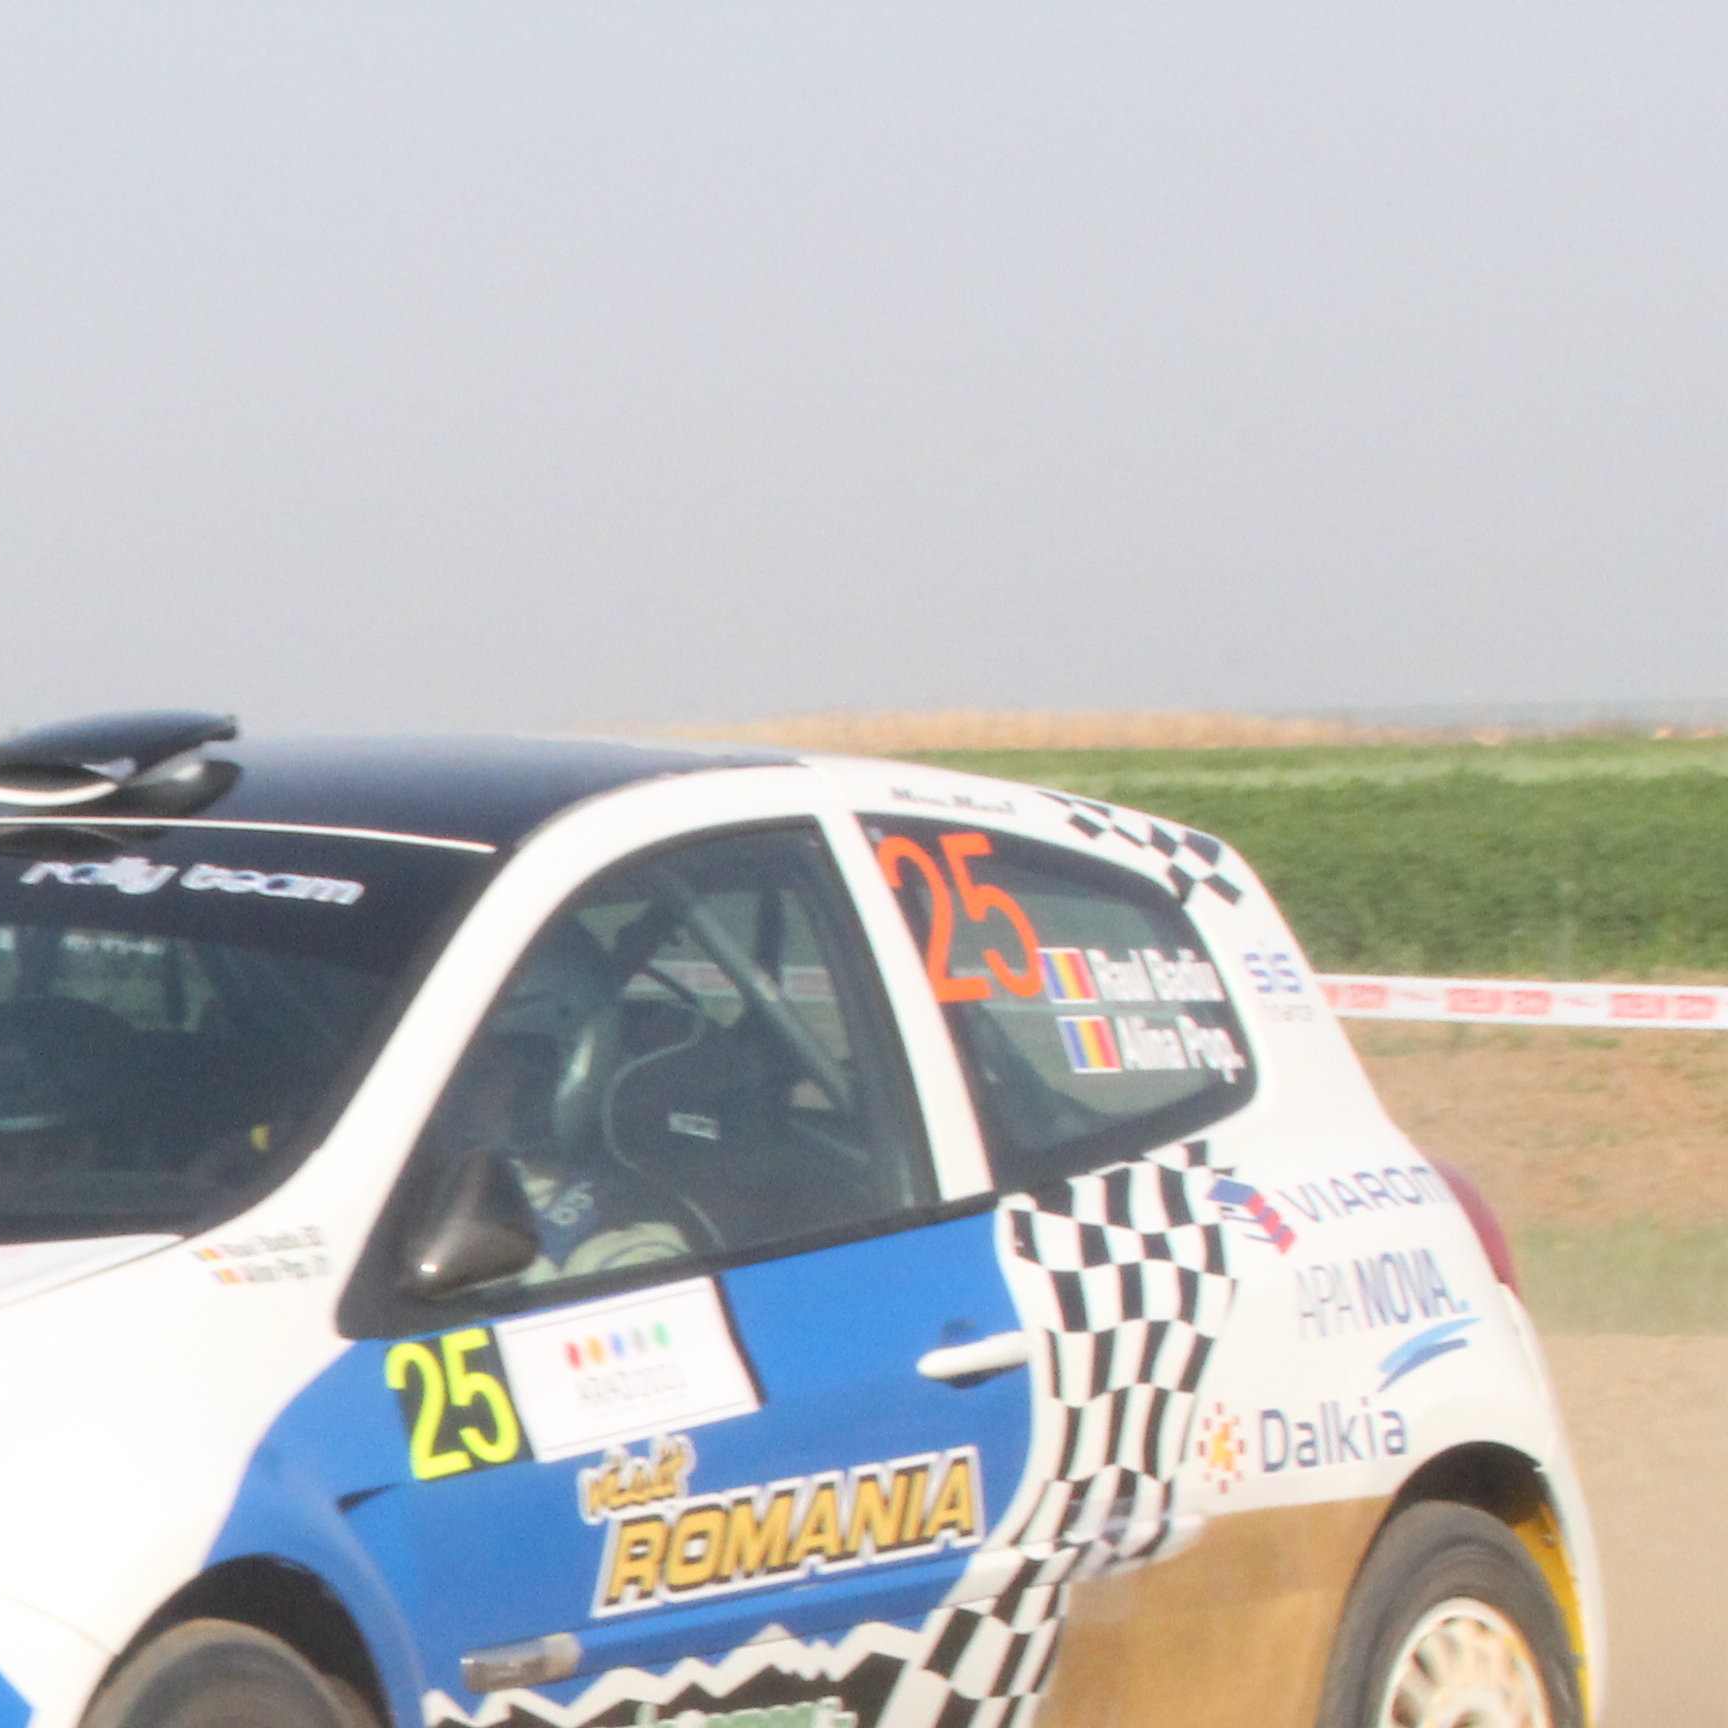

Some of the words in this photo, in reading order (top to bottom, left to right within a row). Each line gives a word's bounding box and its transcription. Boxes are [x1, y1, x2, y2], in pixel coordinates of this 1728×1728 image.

[180, 863, 365, 905] team
[877, 833, 1046, 1003] 25
[385, 1326, 520, 1481] 25
[1260, 1397, 1409, 1473] Dalkia
[595, 1449, 982, 1613] ROMANIA
